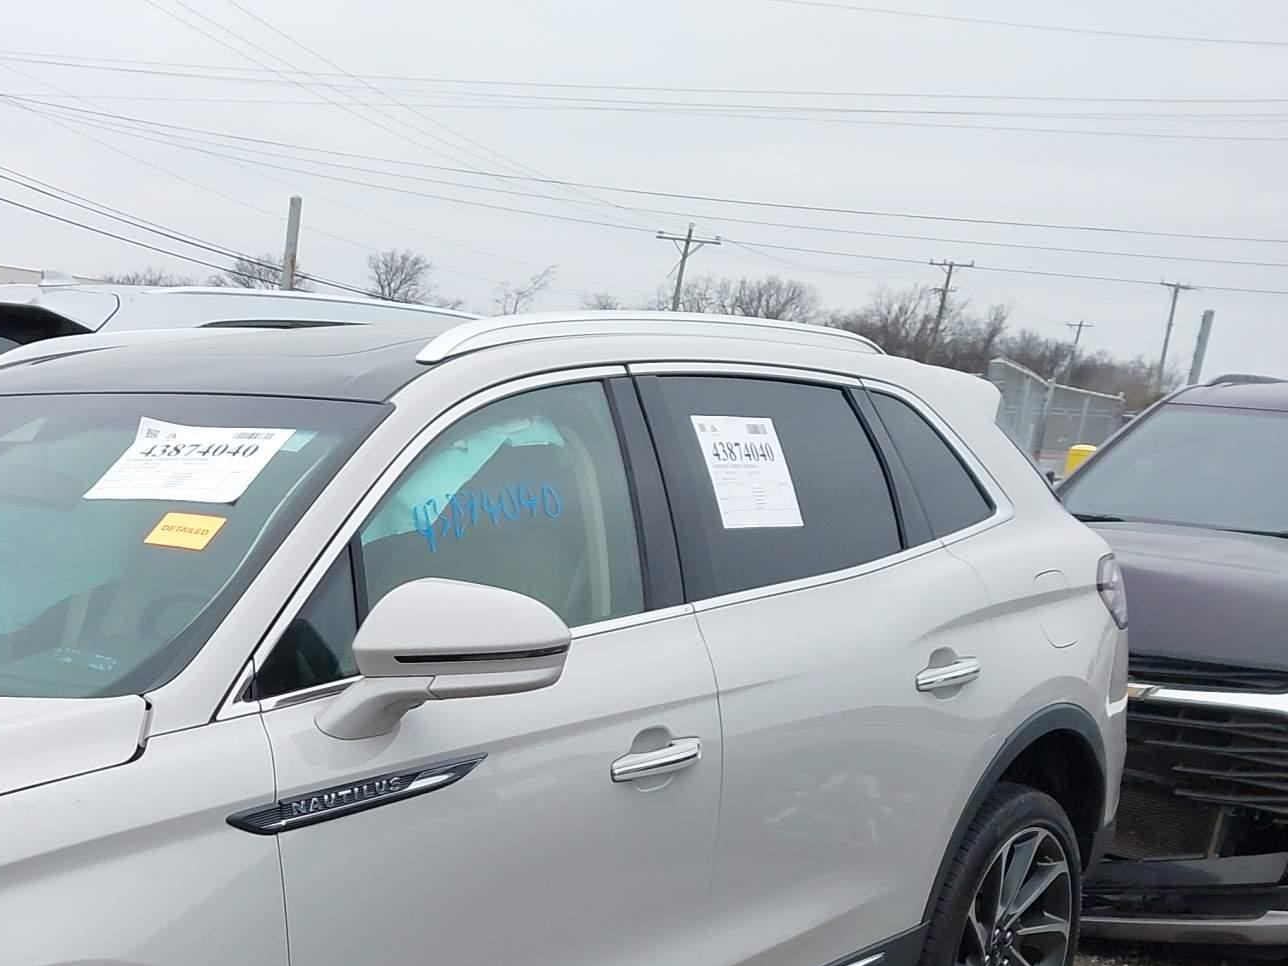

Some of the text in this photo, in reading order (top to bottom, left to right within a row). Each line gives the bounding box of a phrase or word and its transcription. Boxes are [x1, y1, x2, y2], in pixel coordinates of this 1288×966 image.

[140, 443, 260, 458] 43874040
[712, 441, 775, 462] 43874040
[413, 479, 561, 555] 43874040
[161, 524, 210, 537] DETAILED
[292, 776, 402, 816] NAUTILUS
